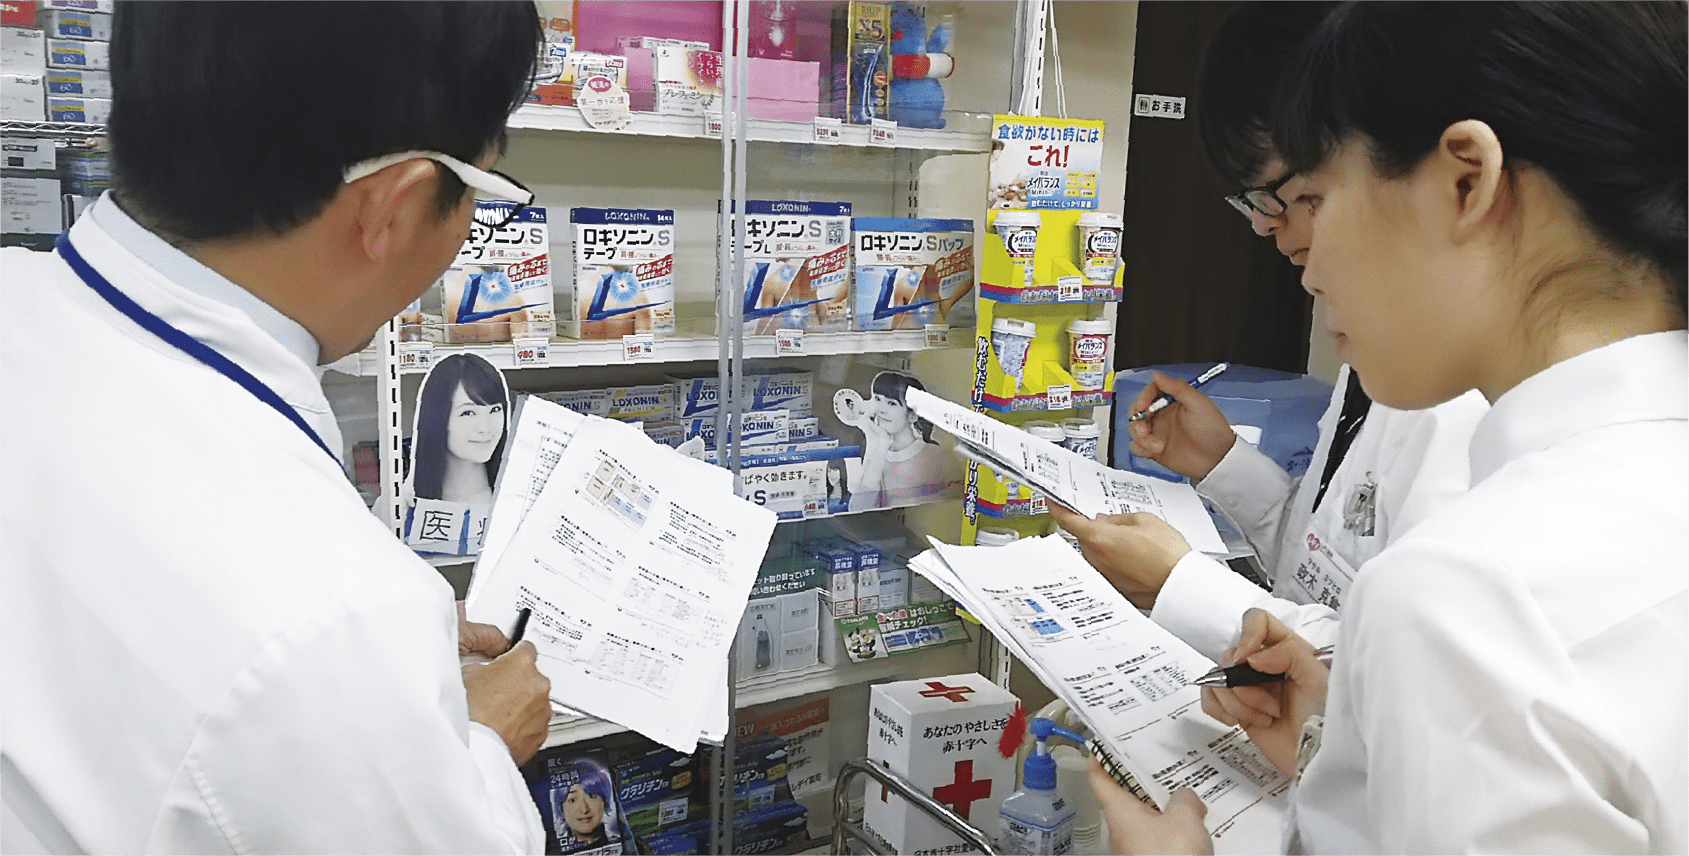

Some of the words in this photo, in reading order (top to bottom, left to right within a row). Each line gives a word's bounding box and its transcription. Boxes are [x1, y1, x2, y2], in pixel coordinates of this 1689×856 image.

[1152, 100, 1182, 114] お手洗
[998, 124, 1099, 143] 食欲がない時には
[1026, 177, 1060, 189] メイバランス
[772, 203, 810, 213] LOXONIN
[605, 211, 650, 221] LOXONIN
[861, 234, 964, 252] ロキソニンSパップ
[583, 247, 617, 260] テープ
[753, 386, 801, 397] LOXONIN
[612, 396, 659, 407] LOXONIN
[923, 723, 963, 739] あなたの
[943, 737, 988, 754] 赤十字へ
